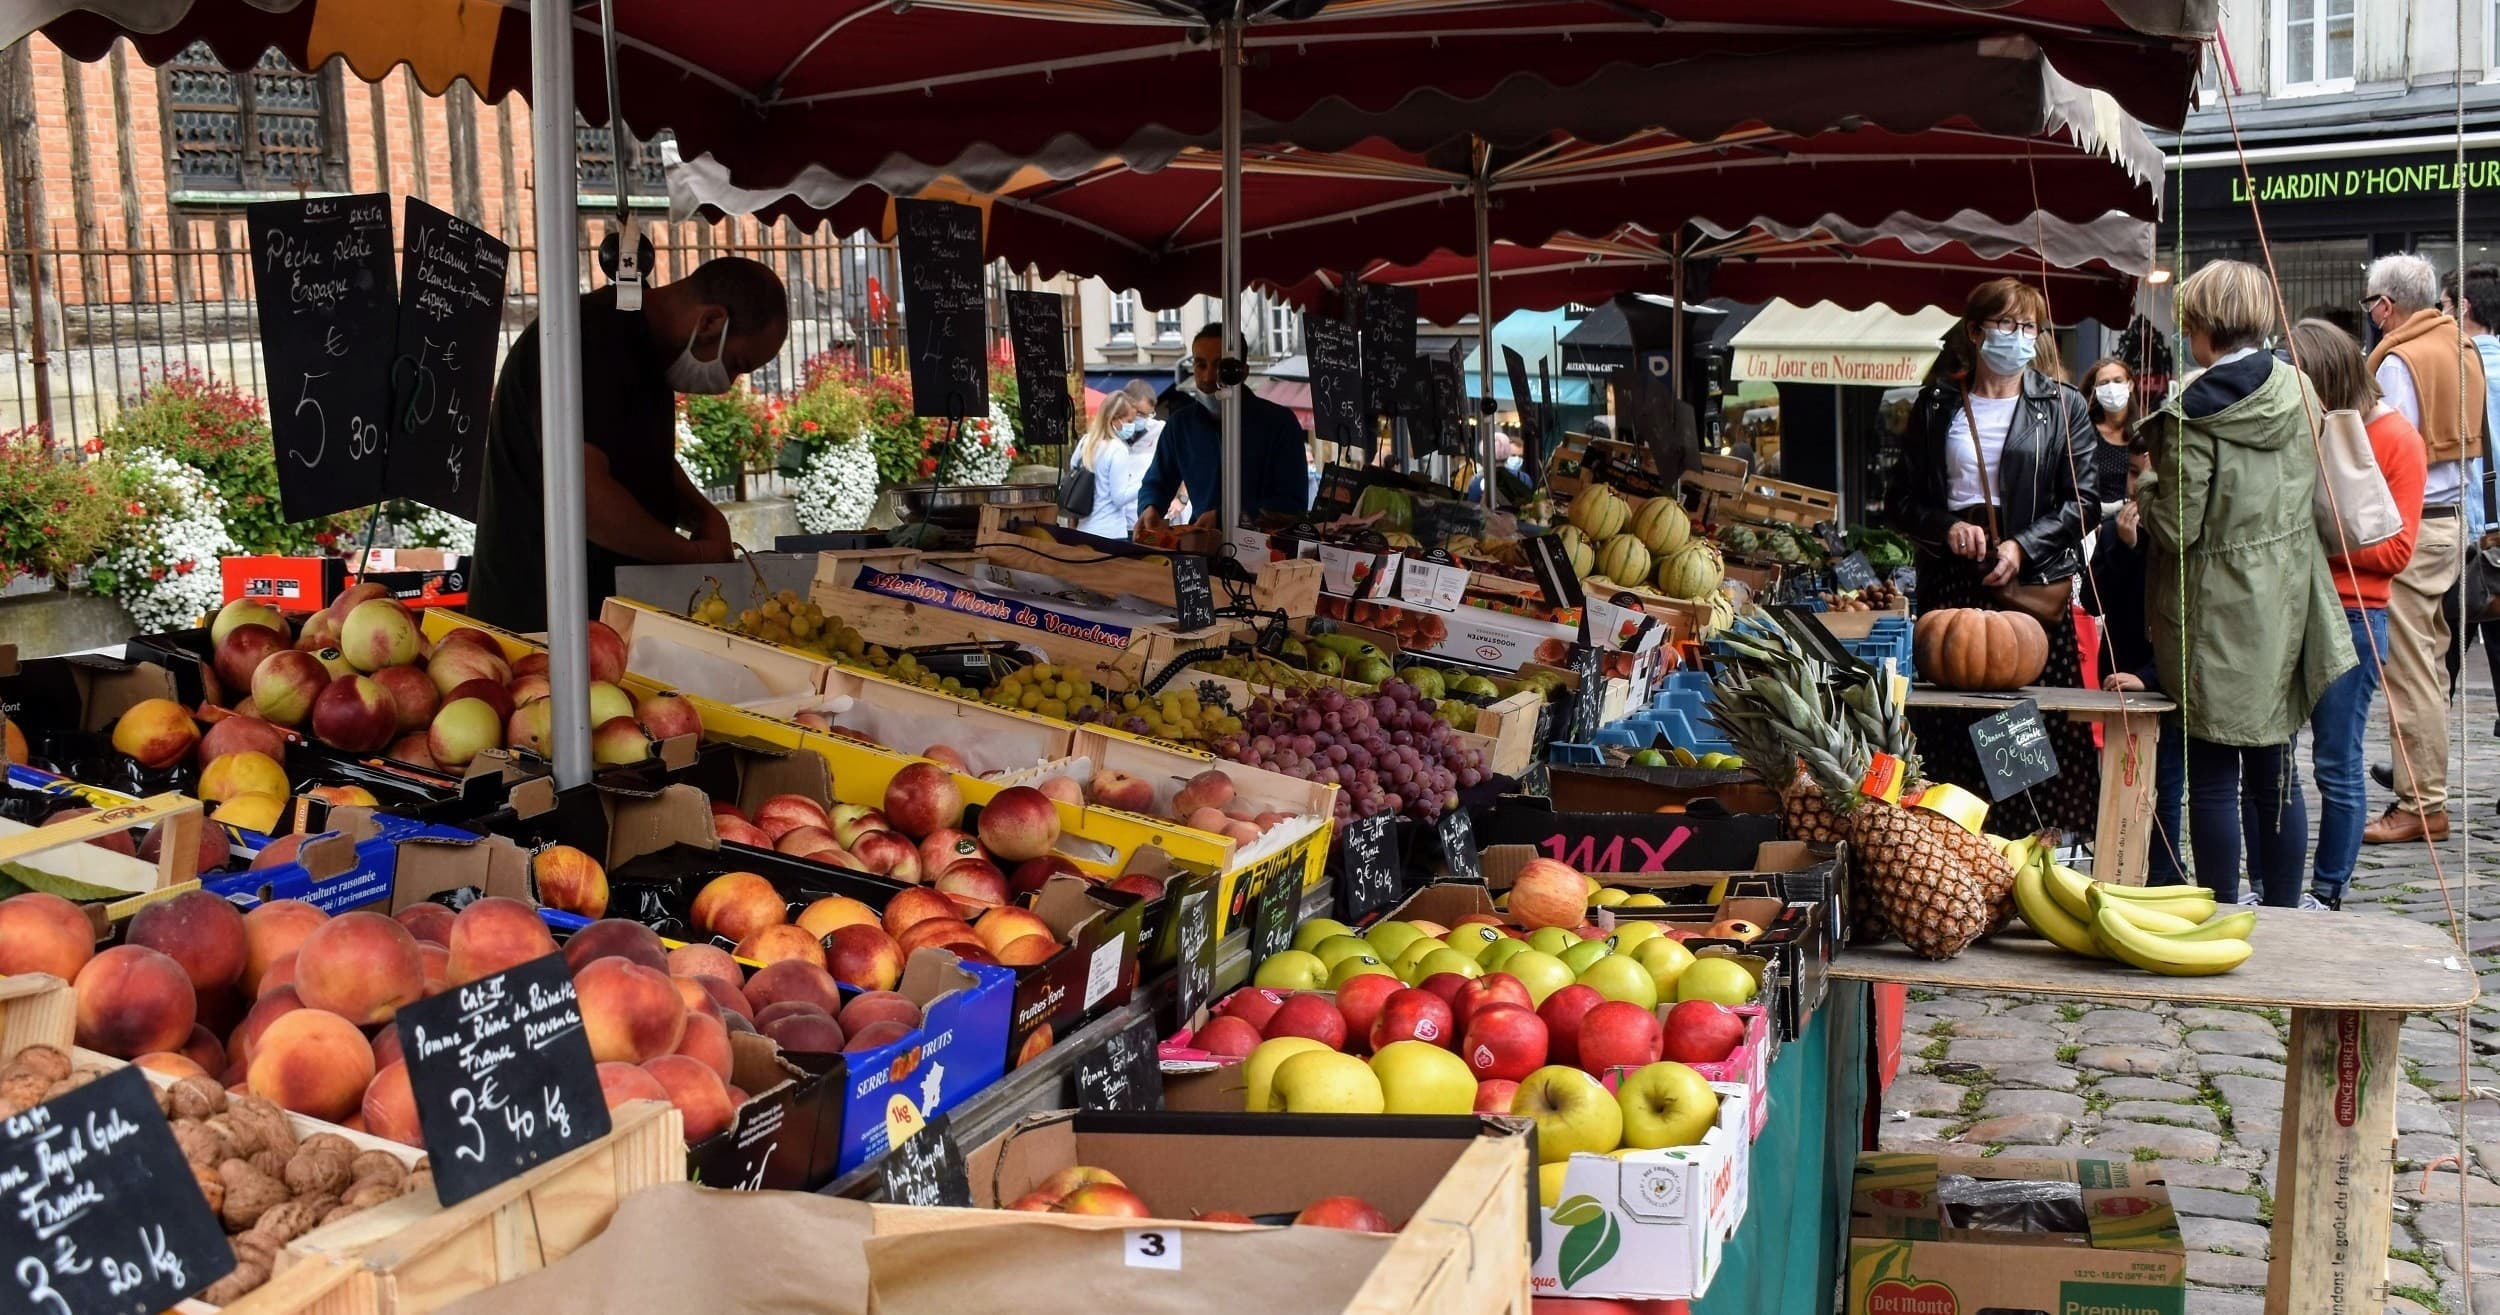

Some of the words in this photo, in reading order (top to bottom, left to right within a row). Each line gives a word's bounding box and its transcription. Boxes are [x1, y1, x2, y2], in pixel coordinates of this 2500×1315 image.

[2232, 178, 2256, 202] LE
[2260, 171, 2339, 200] JARDIN
[2345, 160, 2500, 196] D'HONFLEUR
[267, 228, 320, 272] Pêche
[410, 225, 470, 273] Nectarine
[291, 270, 348, 311] Espagne
[1747, 354, 1767, 377] Un
[1772, 354, 1807, 379] Jour
[1811, 360, 1828, 378] en
[1832, 355, 1917, 381] Normandie
[289, 372, 331, 468] 5
[350, 416, 378, 460] 30
[447, 444, 463, 492] Kg
[951, 589, 1011, 620] Monts
[1015, 607, 1038, 627] de
[1044, 613, 1130, 649] Vaucluse
[1467, 633, 1516, 647] HOOGSTRATEN
[1, 701, 21, 712] font
[2034, 748, 2048, 772] Kg
[2120, 817, 2128, 838] frais
[338, 883, 387, 906] Environnement
[339, 870, 376, 892] raisonnée
[1138, 927, 1154, 943] font
[460, 986, 485, 1011] Cat
[1019, 997, 1047, 1025] fruites
[1048, 985, 1065, 1007] font
[415, 1025, 461, 1061] Pomme
[474, 1013, 510, 1042] Reine
[513, 1003, 529, 1023] de
[529, 982, 577, 1014] Reinette
[459, 1044, 515, 1073] France
[856, 1067, 889, 1099] SERRE
[921, 1029, 953, 1060] FRUITS
[1081, 1066, 1108, 1089] Pomme
[1102, 1075, 1128, 1098] France
[2344, 1070, 2352, 1084] de
[505, 1104, 534, 1142] 40
[544, 1085, 571, 1138] Kg
[892, 1104, 911, 1124] 1kg
[2341, 1086, 2353, 1121] PRINCE
[35, 1127, 88, 1185] Royal
[87, 1107, 139, 1155] Gala
[2335, 1152, 2350, 1190] frais
[19, 1179, 104, 1228] France
[2336, 1192, 2348, 1211] du
[1139, 1233, 1165, 1256] 3
[2333, 1216, 2349, 1247] goût
[101, 1256, 142, 1296] 20
[138, 1223, 186, 1290] Kg
[2332, 1253, 2345, 1270] le
[1872, 1296, 1898, 1312] Del
[1902, 1297, 1952, 1314] Monte
